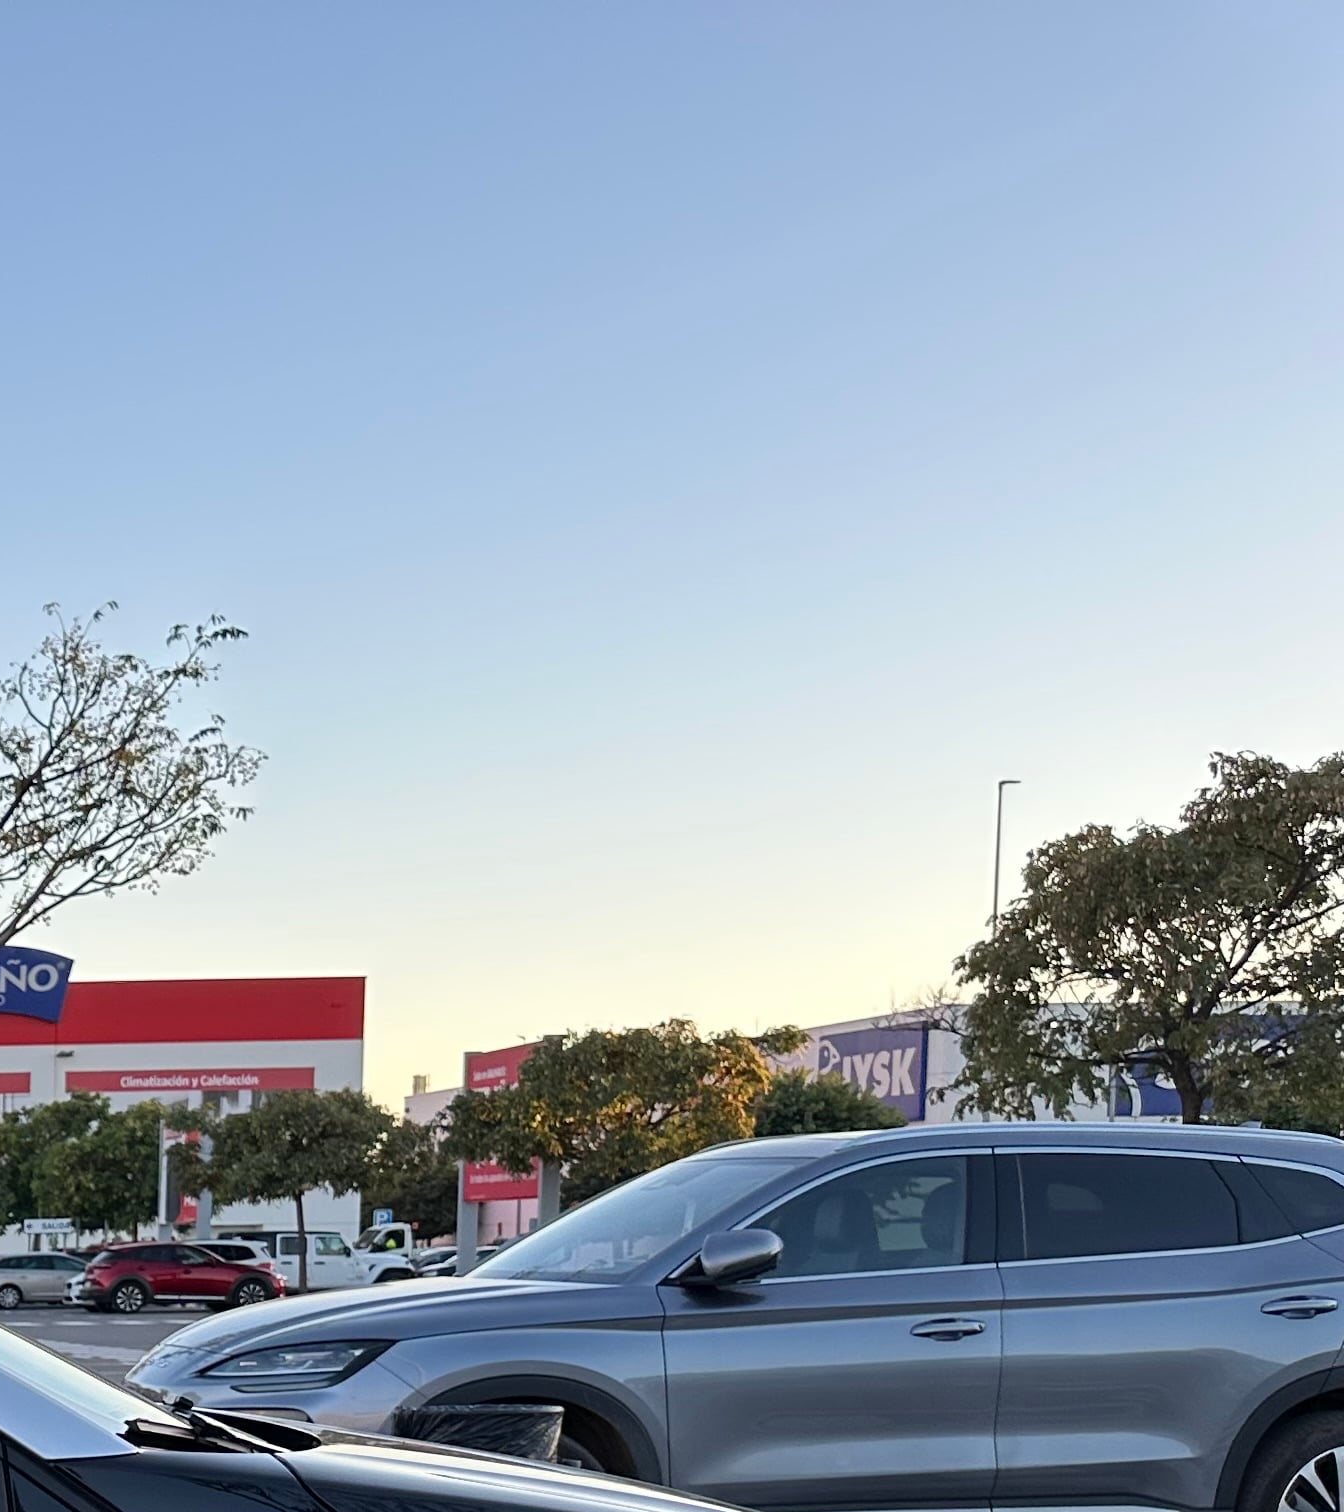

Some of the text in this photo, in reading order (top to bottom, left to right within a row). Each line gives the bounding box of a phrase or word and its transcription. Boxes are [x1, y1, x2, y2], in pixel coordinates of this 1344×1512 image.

[120, 1074, 259, 1088] Climatización y Calefacción
[842, 1047, 916, 1099] JYSK
